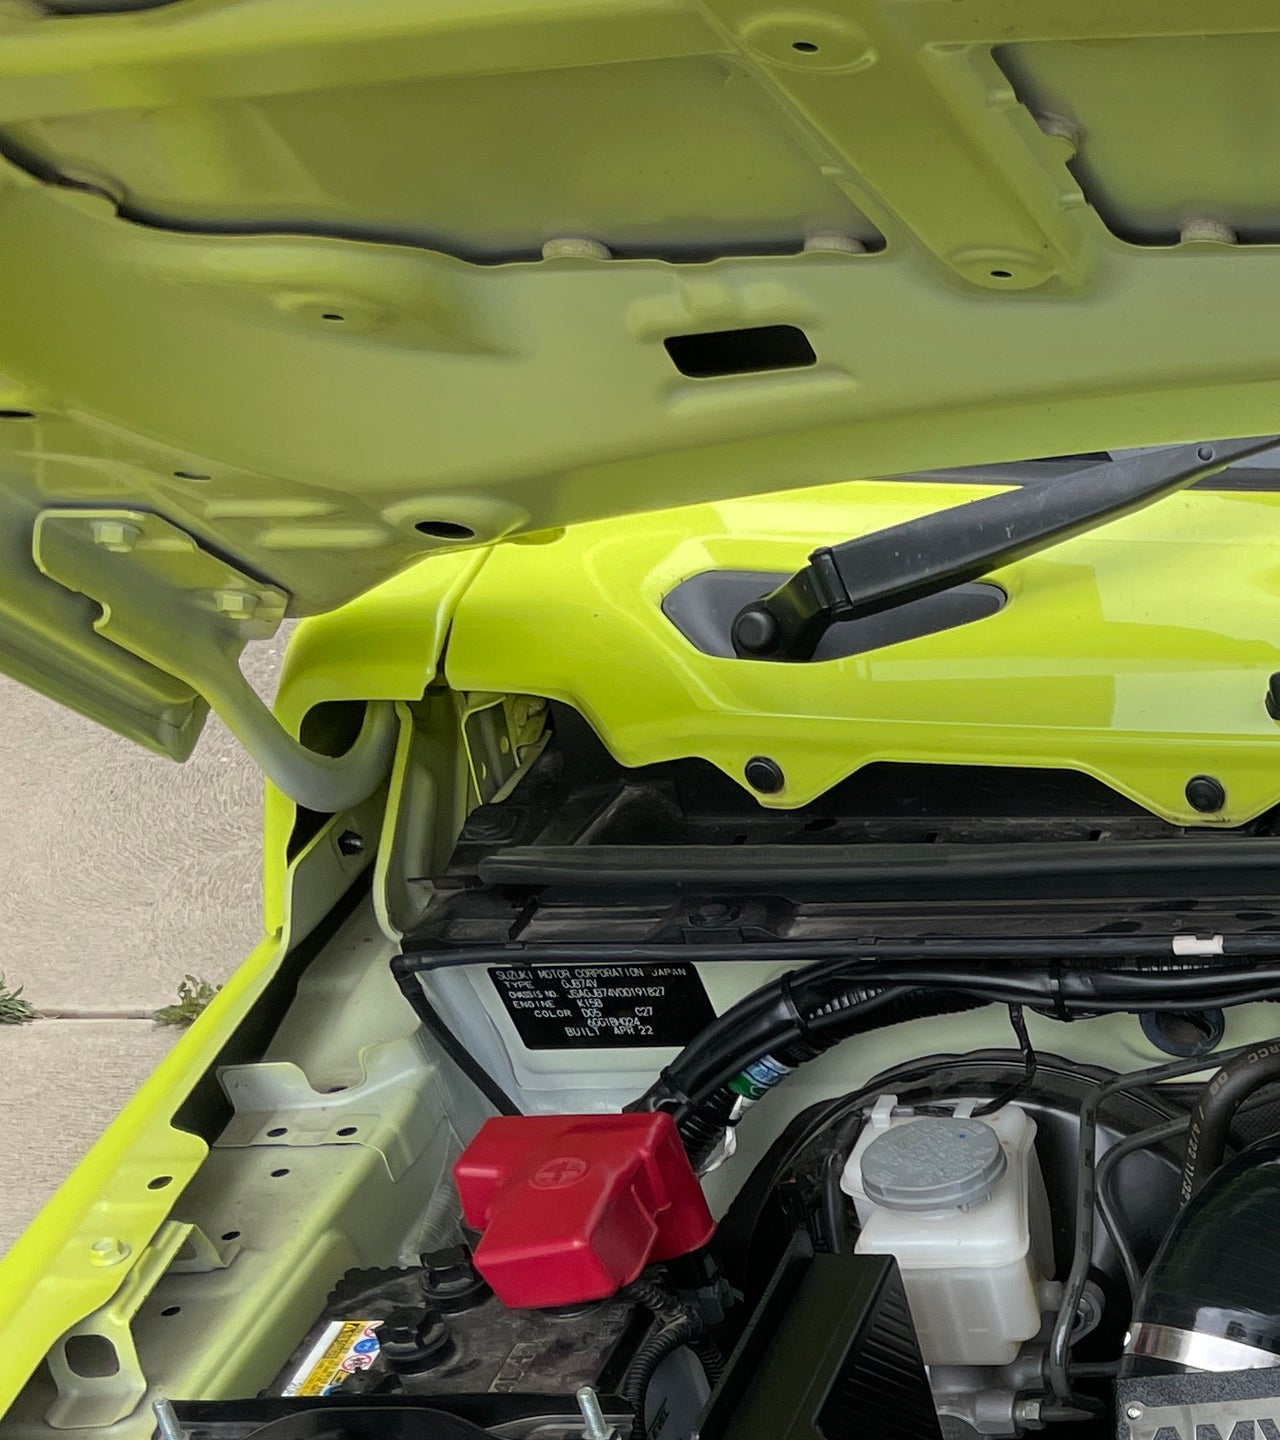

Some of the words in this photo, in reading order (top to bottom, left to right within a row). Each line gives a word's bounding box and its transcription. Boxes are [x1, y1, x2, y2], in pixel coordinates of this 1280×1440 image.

[495, 970, 533, 980] SUZUKI
[537, 970, 571, 979] MOTOR
[574, 968, 645, 978] CORPORATION
[652, 968, 687, 976] JAPAN
[503, 981, 535, 989] TYPE
[512, 1000, 556, 1009] ENGINE
[534, 1009, 573, 1018] COLOR
[634, 1006, 653, 1016] C27
[564, 1026, 600, 1037] BUILT
[614, 1026, 635, 1035] APR
